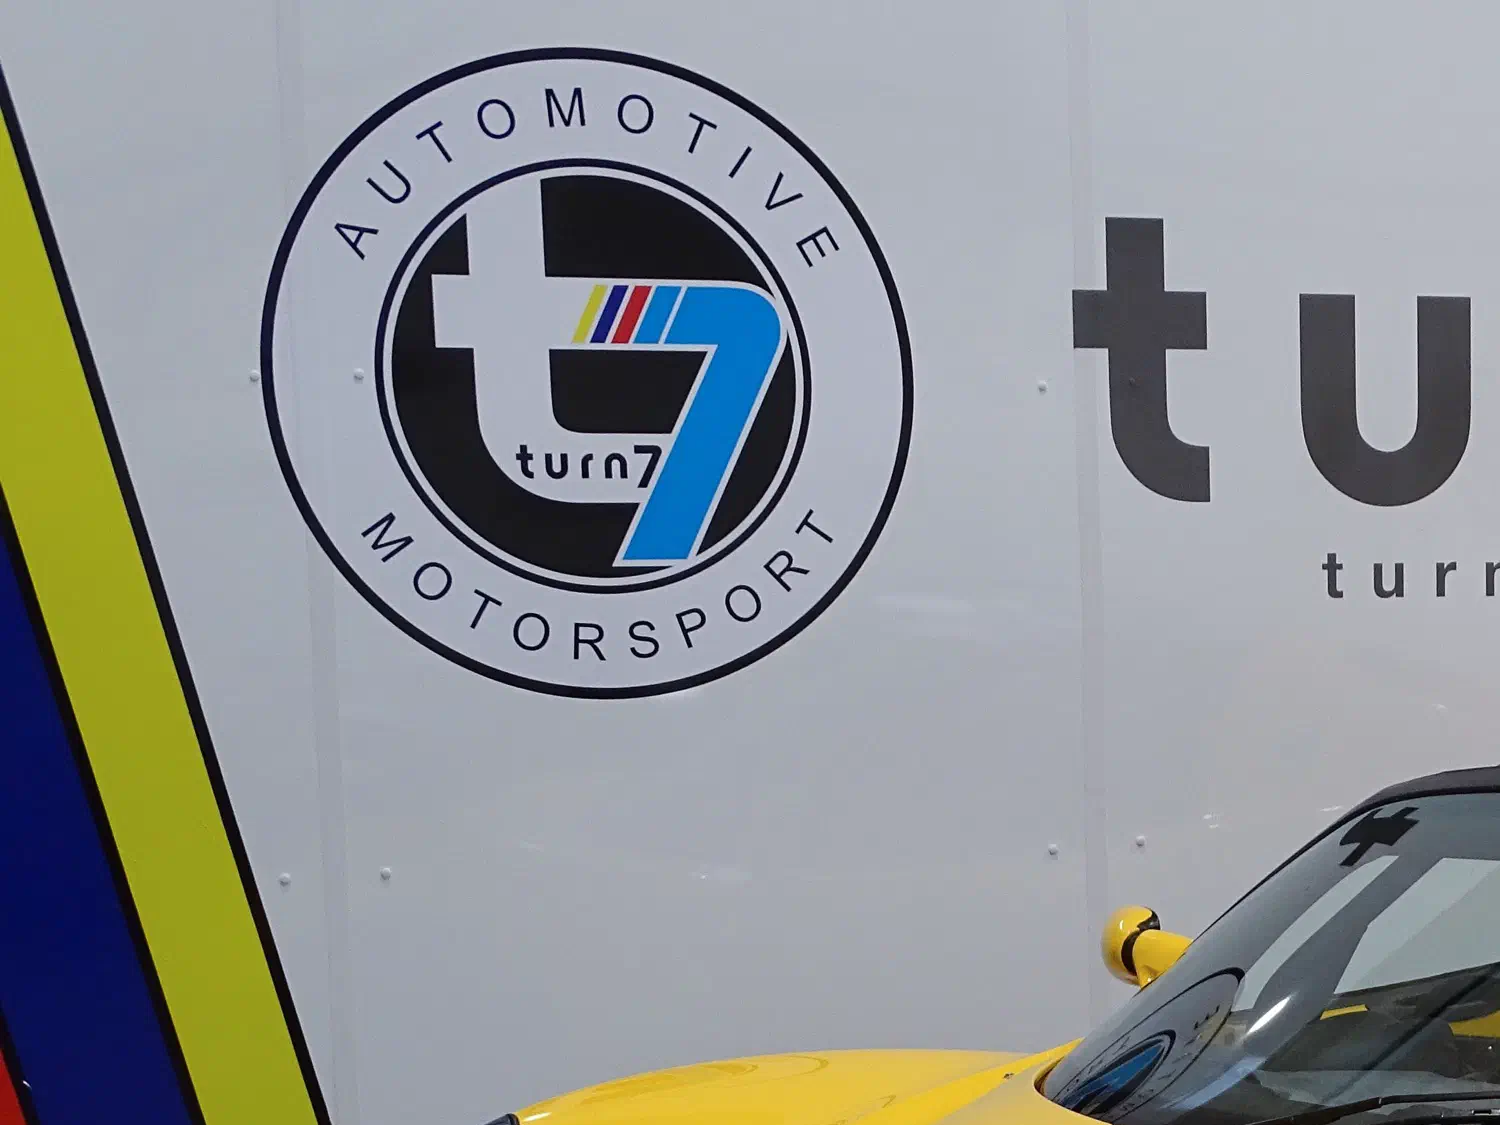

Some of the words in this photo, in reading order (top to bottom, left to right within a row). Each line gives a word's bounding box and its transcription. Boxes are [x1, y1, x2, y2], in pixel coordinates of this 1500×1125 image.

[335, 88, 840, 267] AUTOMOTIVE
[515, 444, 663, 489] turn7
[361, 509, 834, 661] MOTORSPORT
